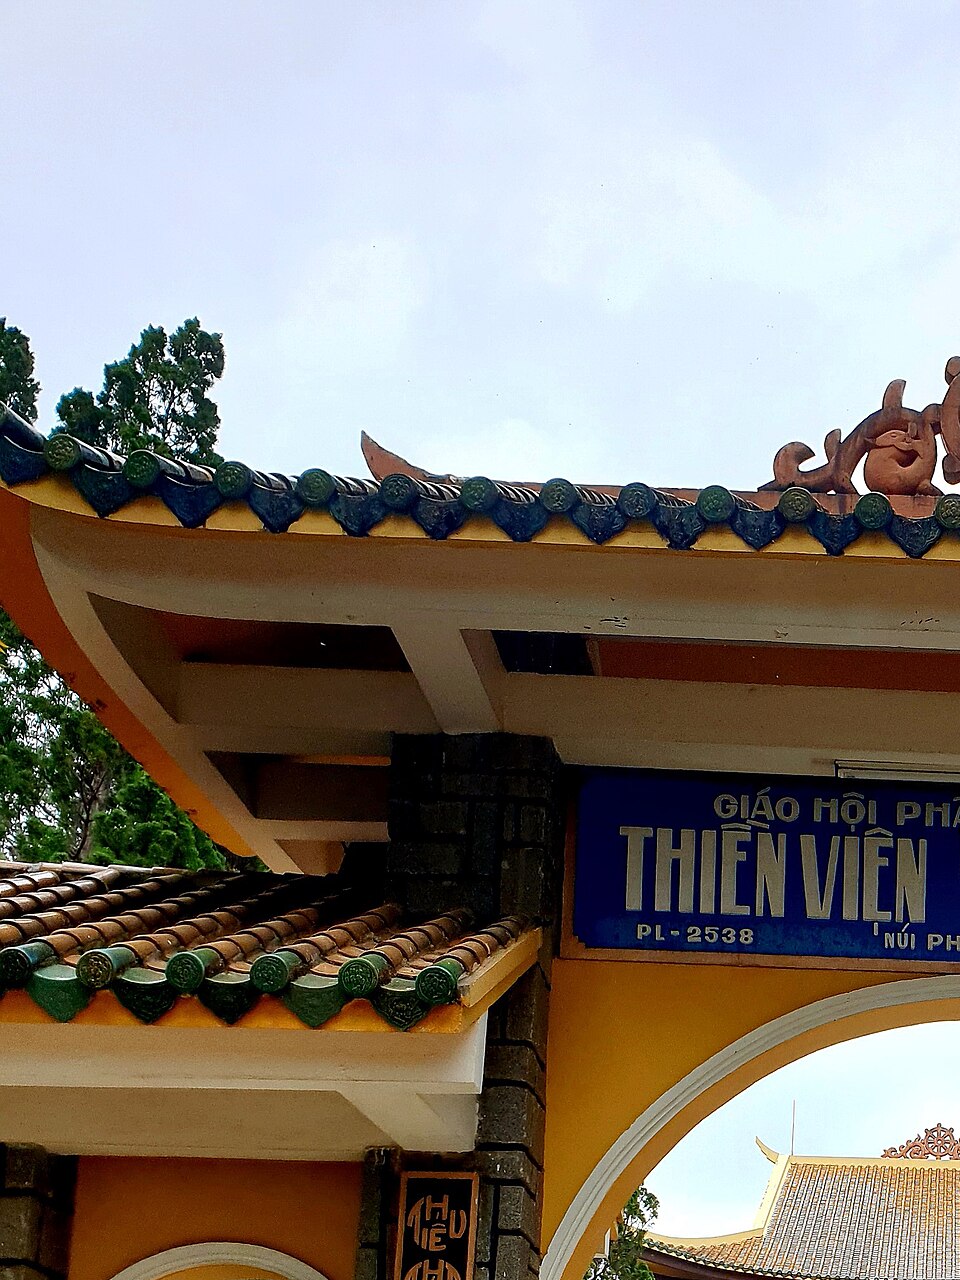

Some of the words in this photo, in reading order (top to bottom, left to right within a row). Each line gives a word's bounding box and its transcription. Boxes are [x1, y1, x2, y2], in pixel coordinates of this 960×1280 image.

[713, 787, 800, 823] GIÁO
[813, 792, 877, 832] HỘI
[619, 820, 787, 918] THIỀN
[800, 827, 928, 936] VIỆN
[884, 923, 917, 951] NÚI
